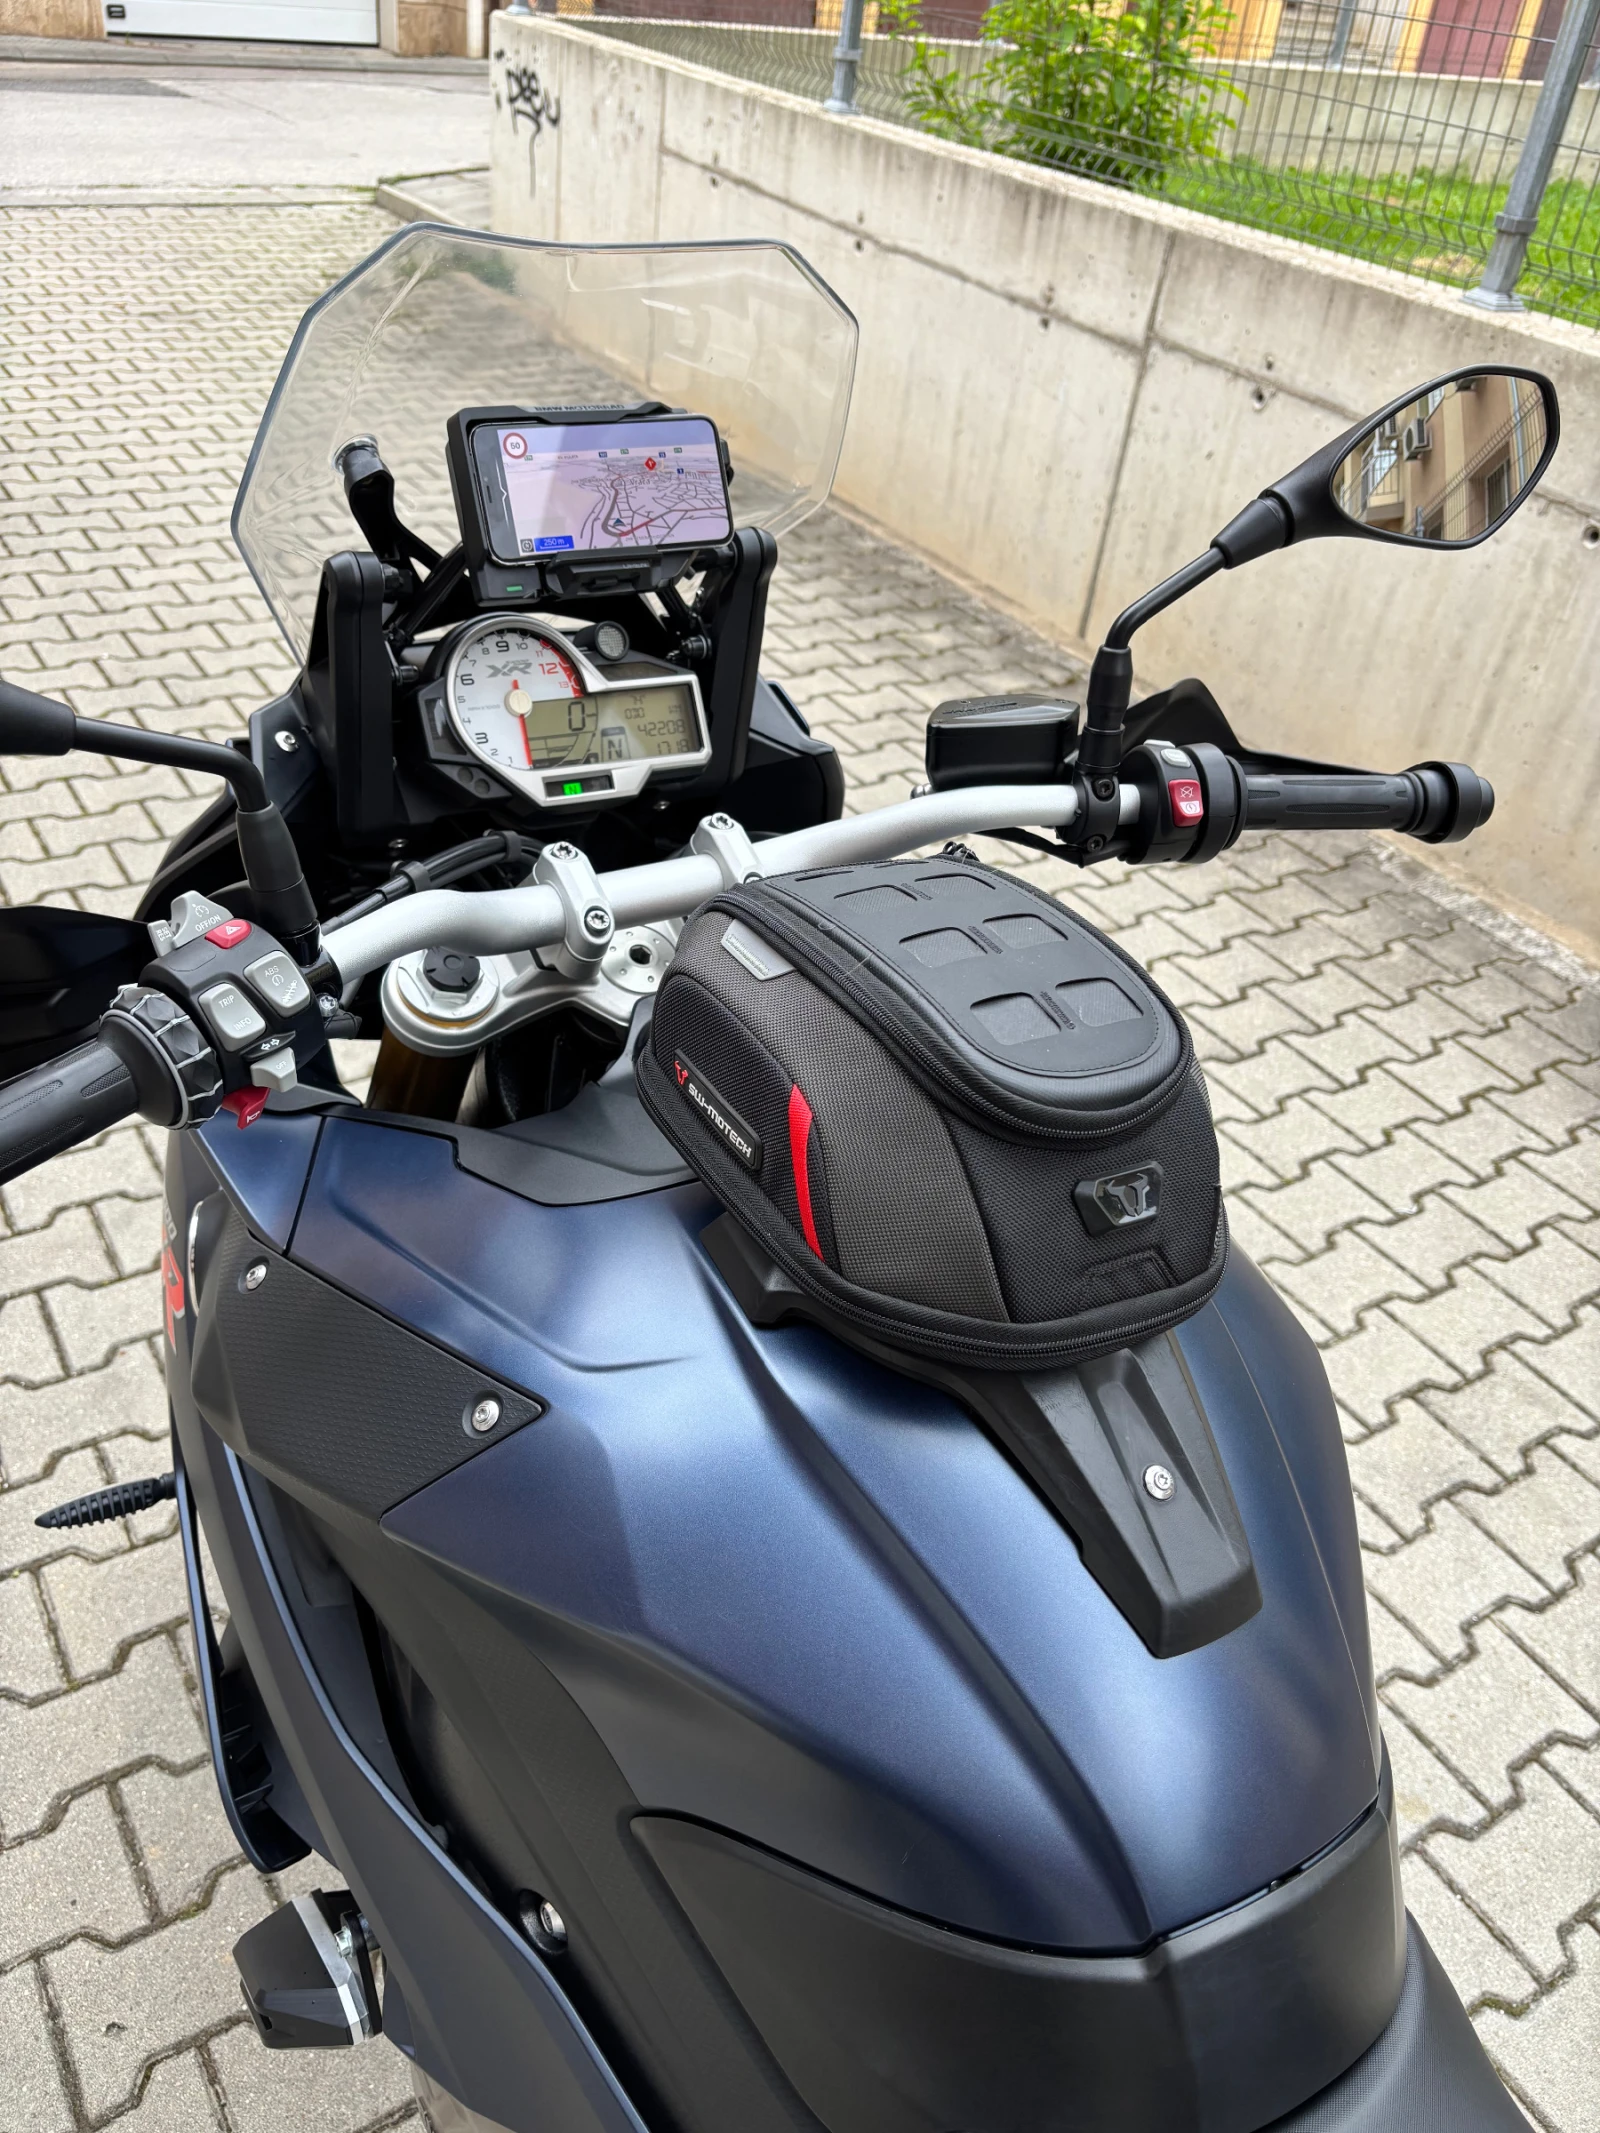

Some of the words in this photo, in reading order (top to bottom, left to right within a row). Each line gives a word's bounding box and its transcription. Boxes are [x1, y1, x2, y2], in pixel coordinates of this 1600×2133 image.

[544, 538, 557, 546] 250
[482, 647, 490, 655] 8
[495, 640, 510, 652] 9
[468, 659, 476, 668] 7
[485, 661, 532, 678] XR
[538, 662, 559, 675] 12
[460, 674, 474, 686] 6
[558, 681, 570, 689] 13
[457, 696, 466, 704] 5
[568, 702, 586, 732] 0
[637, 718, 686, 736] 42208
[475, 732, 488, 744] 3
[608, 738, 622, 760] N
[264, 965, 280, 976] ABS
[218, 994, 234, 1008] TRIP
[234, 1018, 252, 1032] INFO
[276, 1060, 287, 1070] OFF
[688, 1082, 752, 1158] SW-MOTECH
